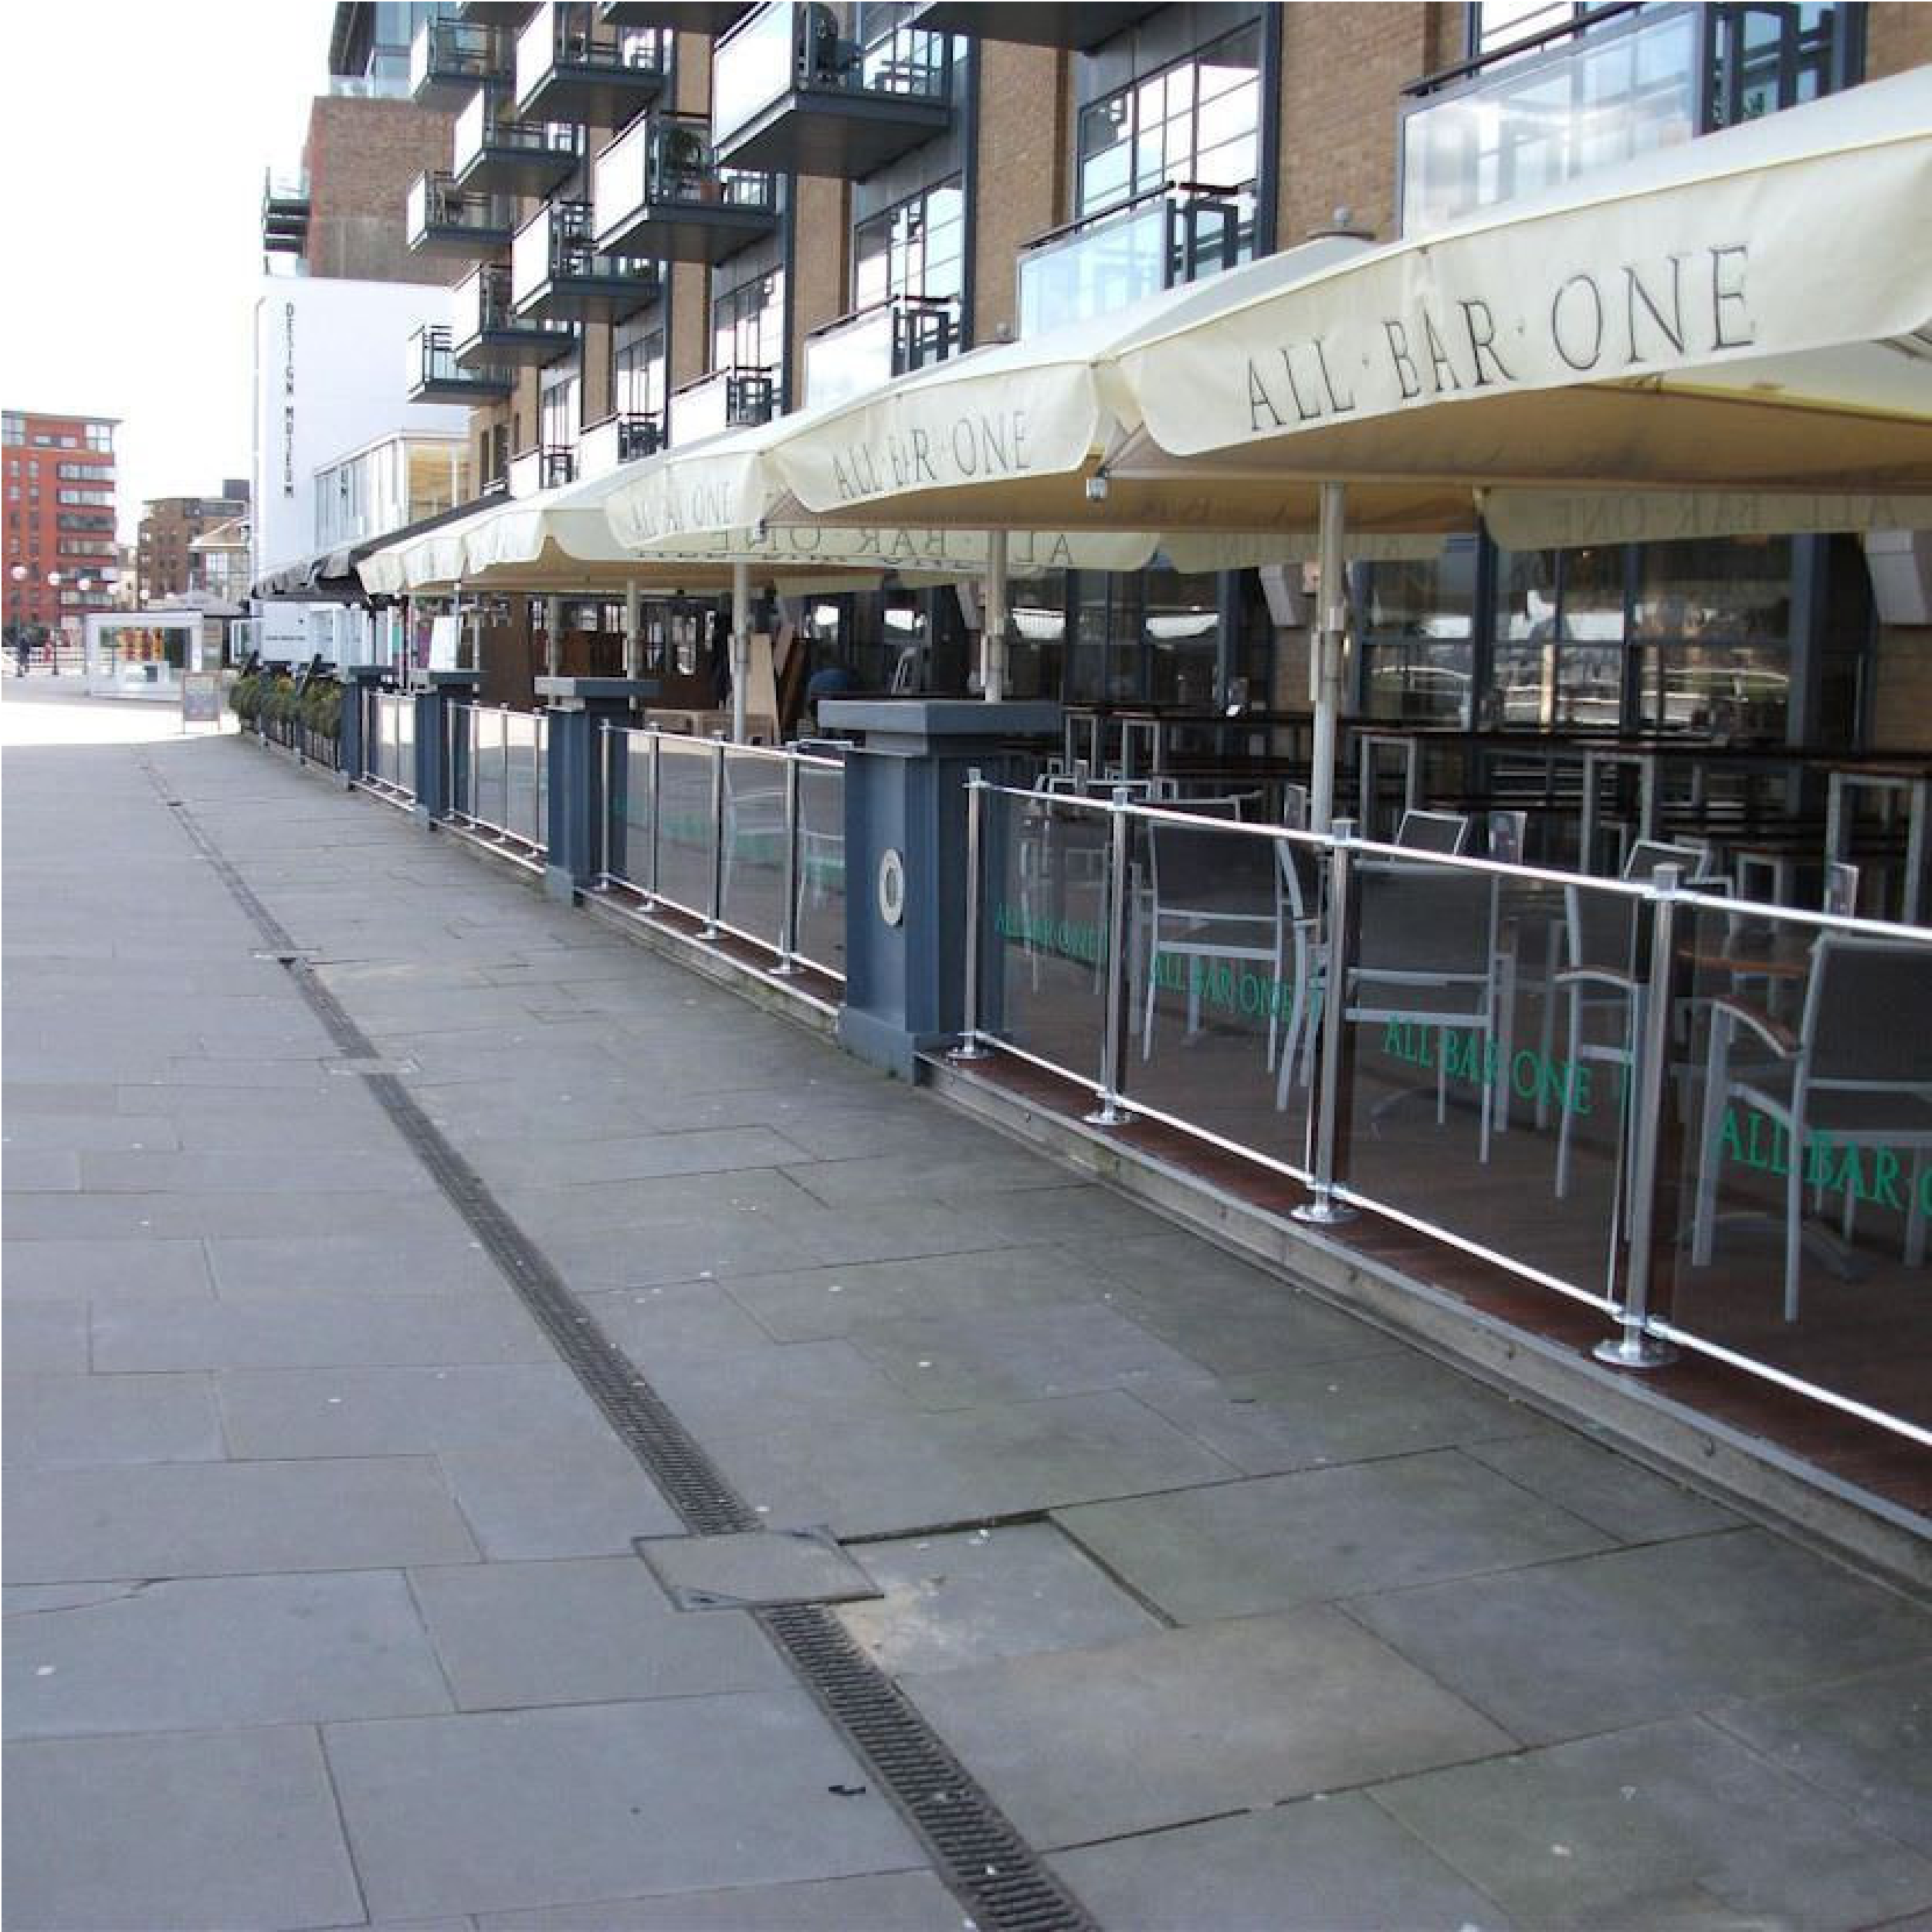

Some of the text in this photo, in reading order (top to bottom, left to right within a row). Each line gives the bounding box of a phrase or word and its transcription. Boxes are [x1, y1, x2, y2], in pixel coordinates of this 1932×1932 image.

[1247, 245, 1754, 432] ALL BAR ONE
[832, 442, 884, 500] ALL
[952, 410, 1032, 477] ONE
[1385, 1015, 1592, 1116] ALL BAR ONE
[1718, 1106, 1798, 1176] ALL
[1802, 1125, 1907, 1212] BAR
